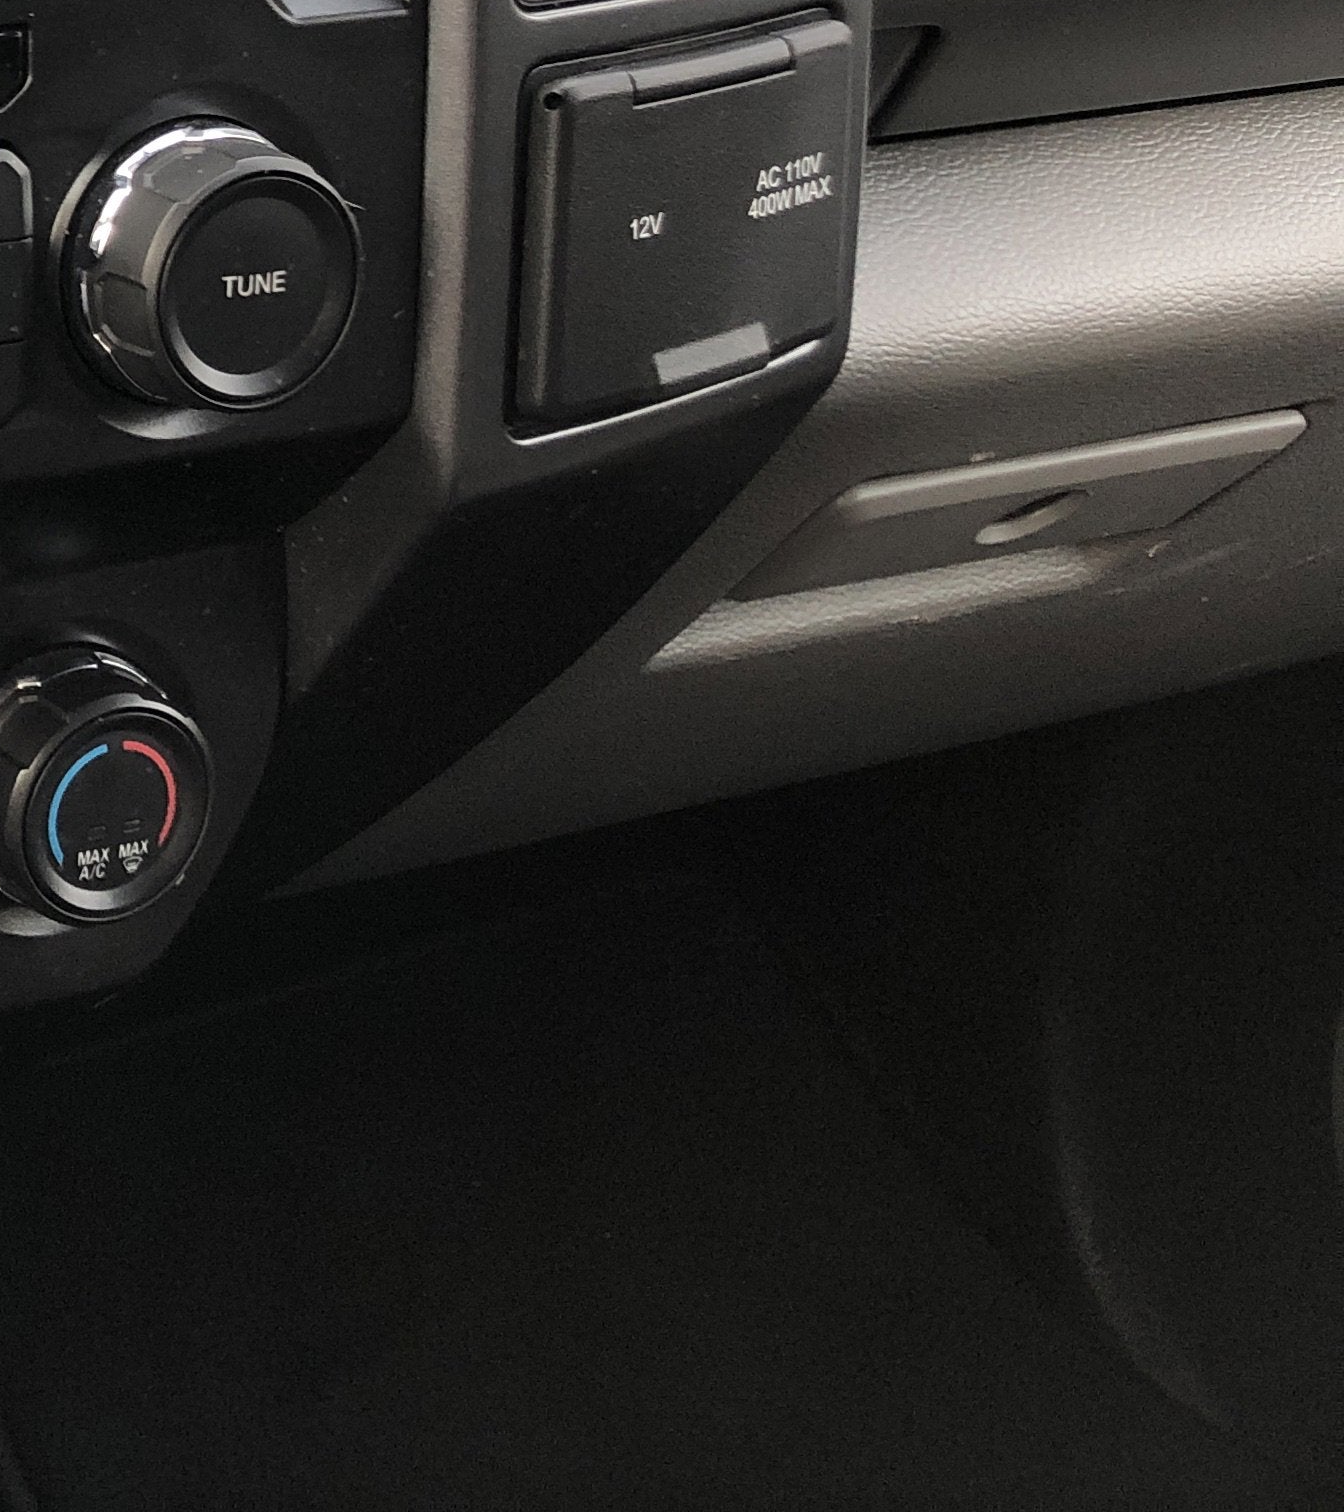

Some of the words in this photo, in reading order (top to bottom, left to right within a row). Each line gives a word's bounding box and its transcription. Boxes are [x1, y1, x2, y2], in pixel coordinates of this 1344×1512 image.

[756, 165, 781, 192] AC
[785, 152, 823, 182] 110V
[747, 187, 793, 219] 400W
[795, 175, 833, 206] MAX
[629, 211, 665, 240] 12V
[221, 270, 287, 298] TUNE
[77, 848, 110, 866] MAX
[118, 840, 149, 858] MAX
[78, 864, 106, 881] A/C
